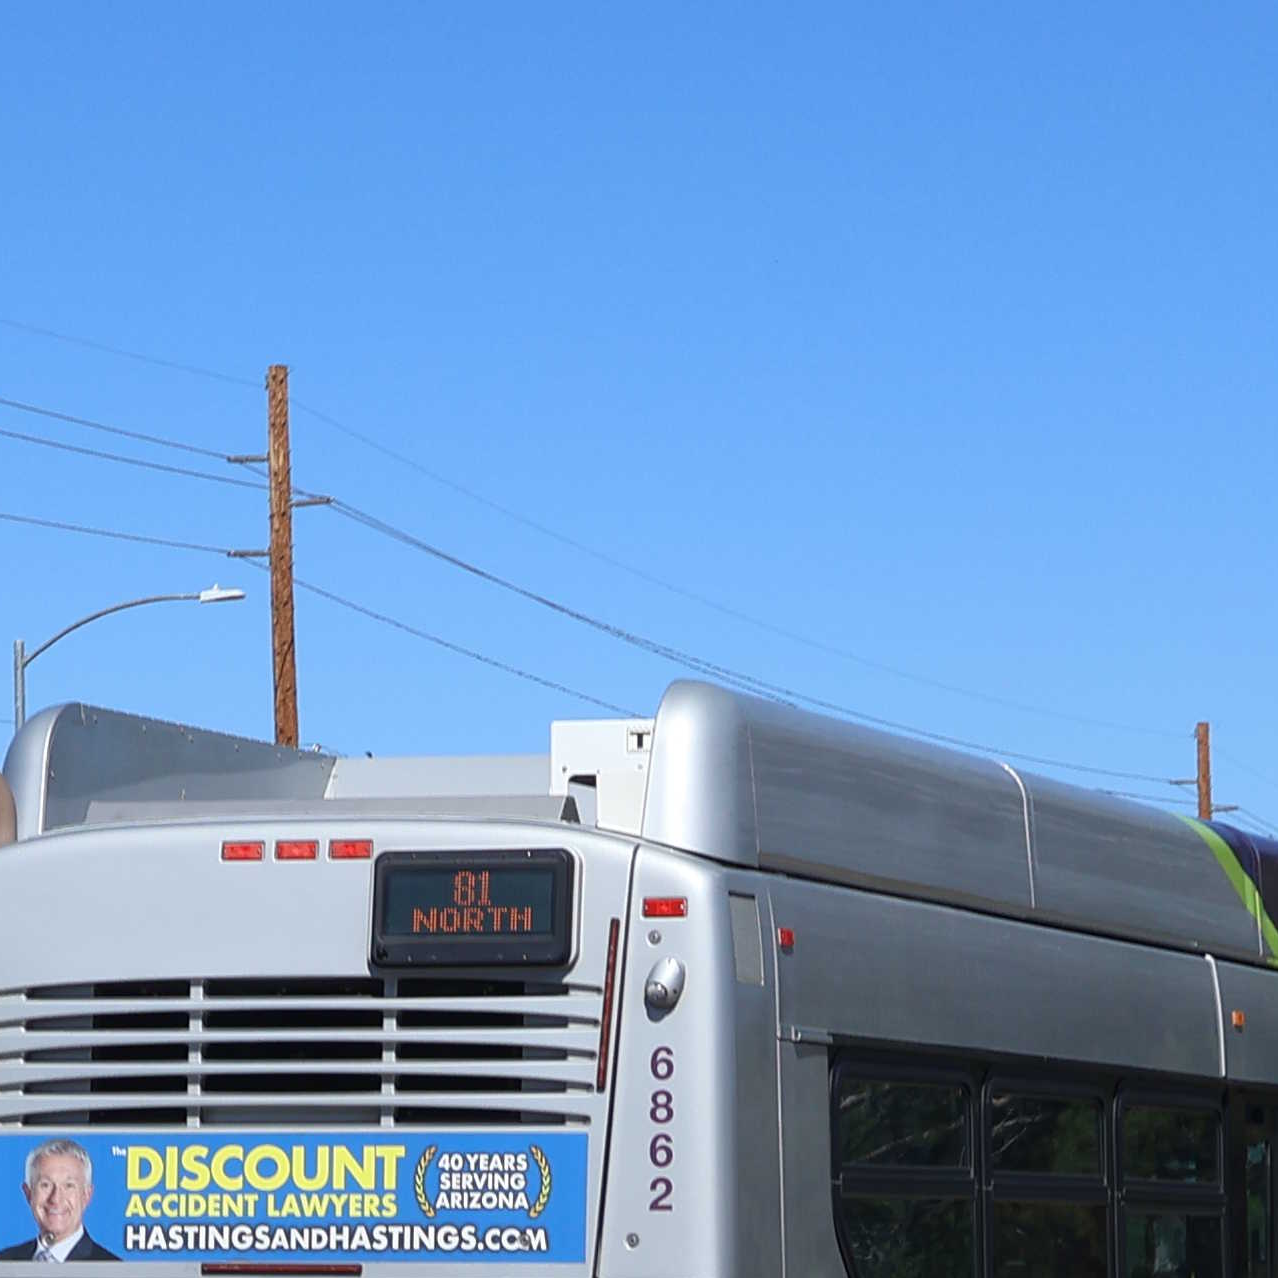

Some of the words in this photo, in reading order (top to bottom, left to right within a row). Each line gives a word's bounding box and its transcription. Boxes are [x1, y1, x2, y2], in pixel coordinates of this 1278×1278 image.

[453, 870, 491, 906] 81
[412, 906, 533, 933] NORTH
[648, 1045, 675, 1212] 6862
[126, 1144, 406, 1191] DISCOUNT
[437, 1153, 464, 1172] 40
[465, 1153, 528, 1172] YEARS
[439, 1172, 526, 1191] SERVING
[124, 1193, 259, 1218] ACCIDENT
[266, 1193, 398, 1218] LAWYERS
[435, 1192, 529, 1210] ARIZONA
